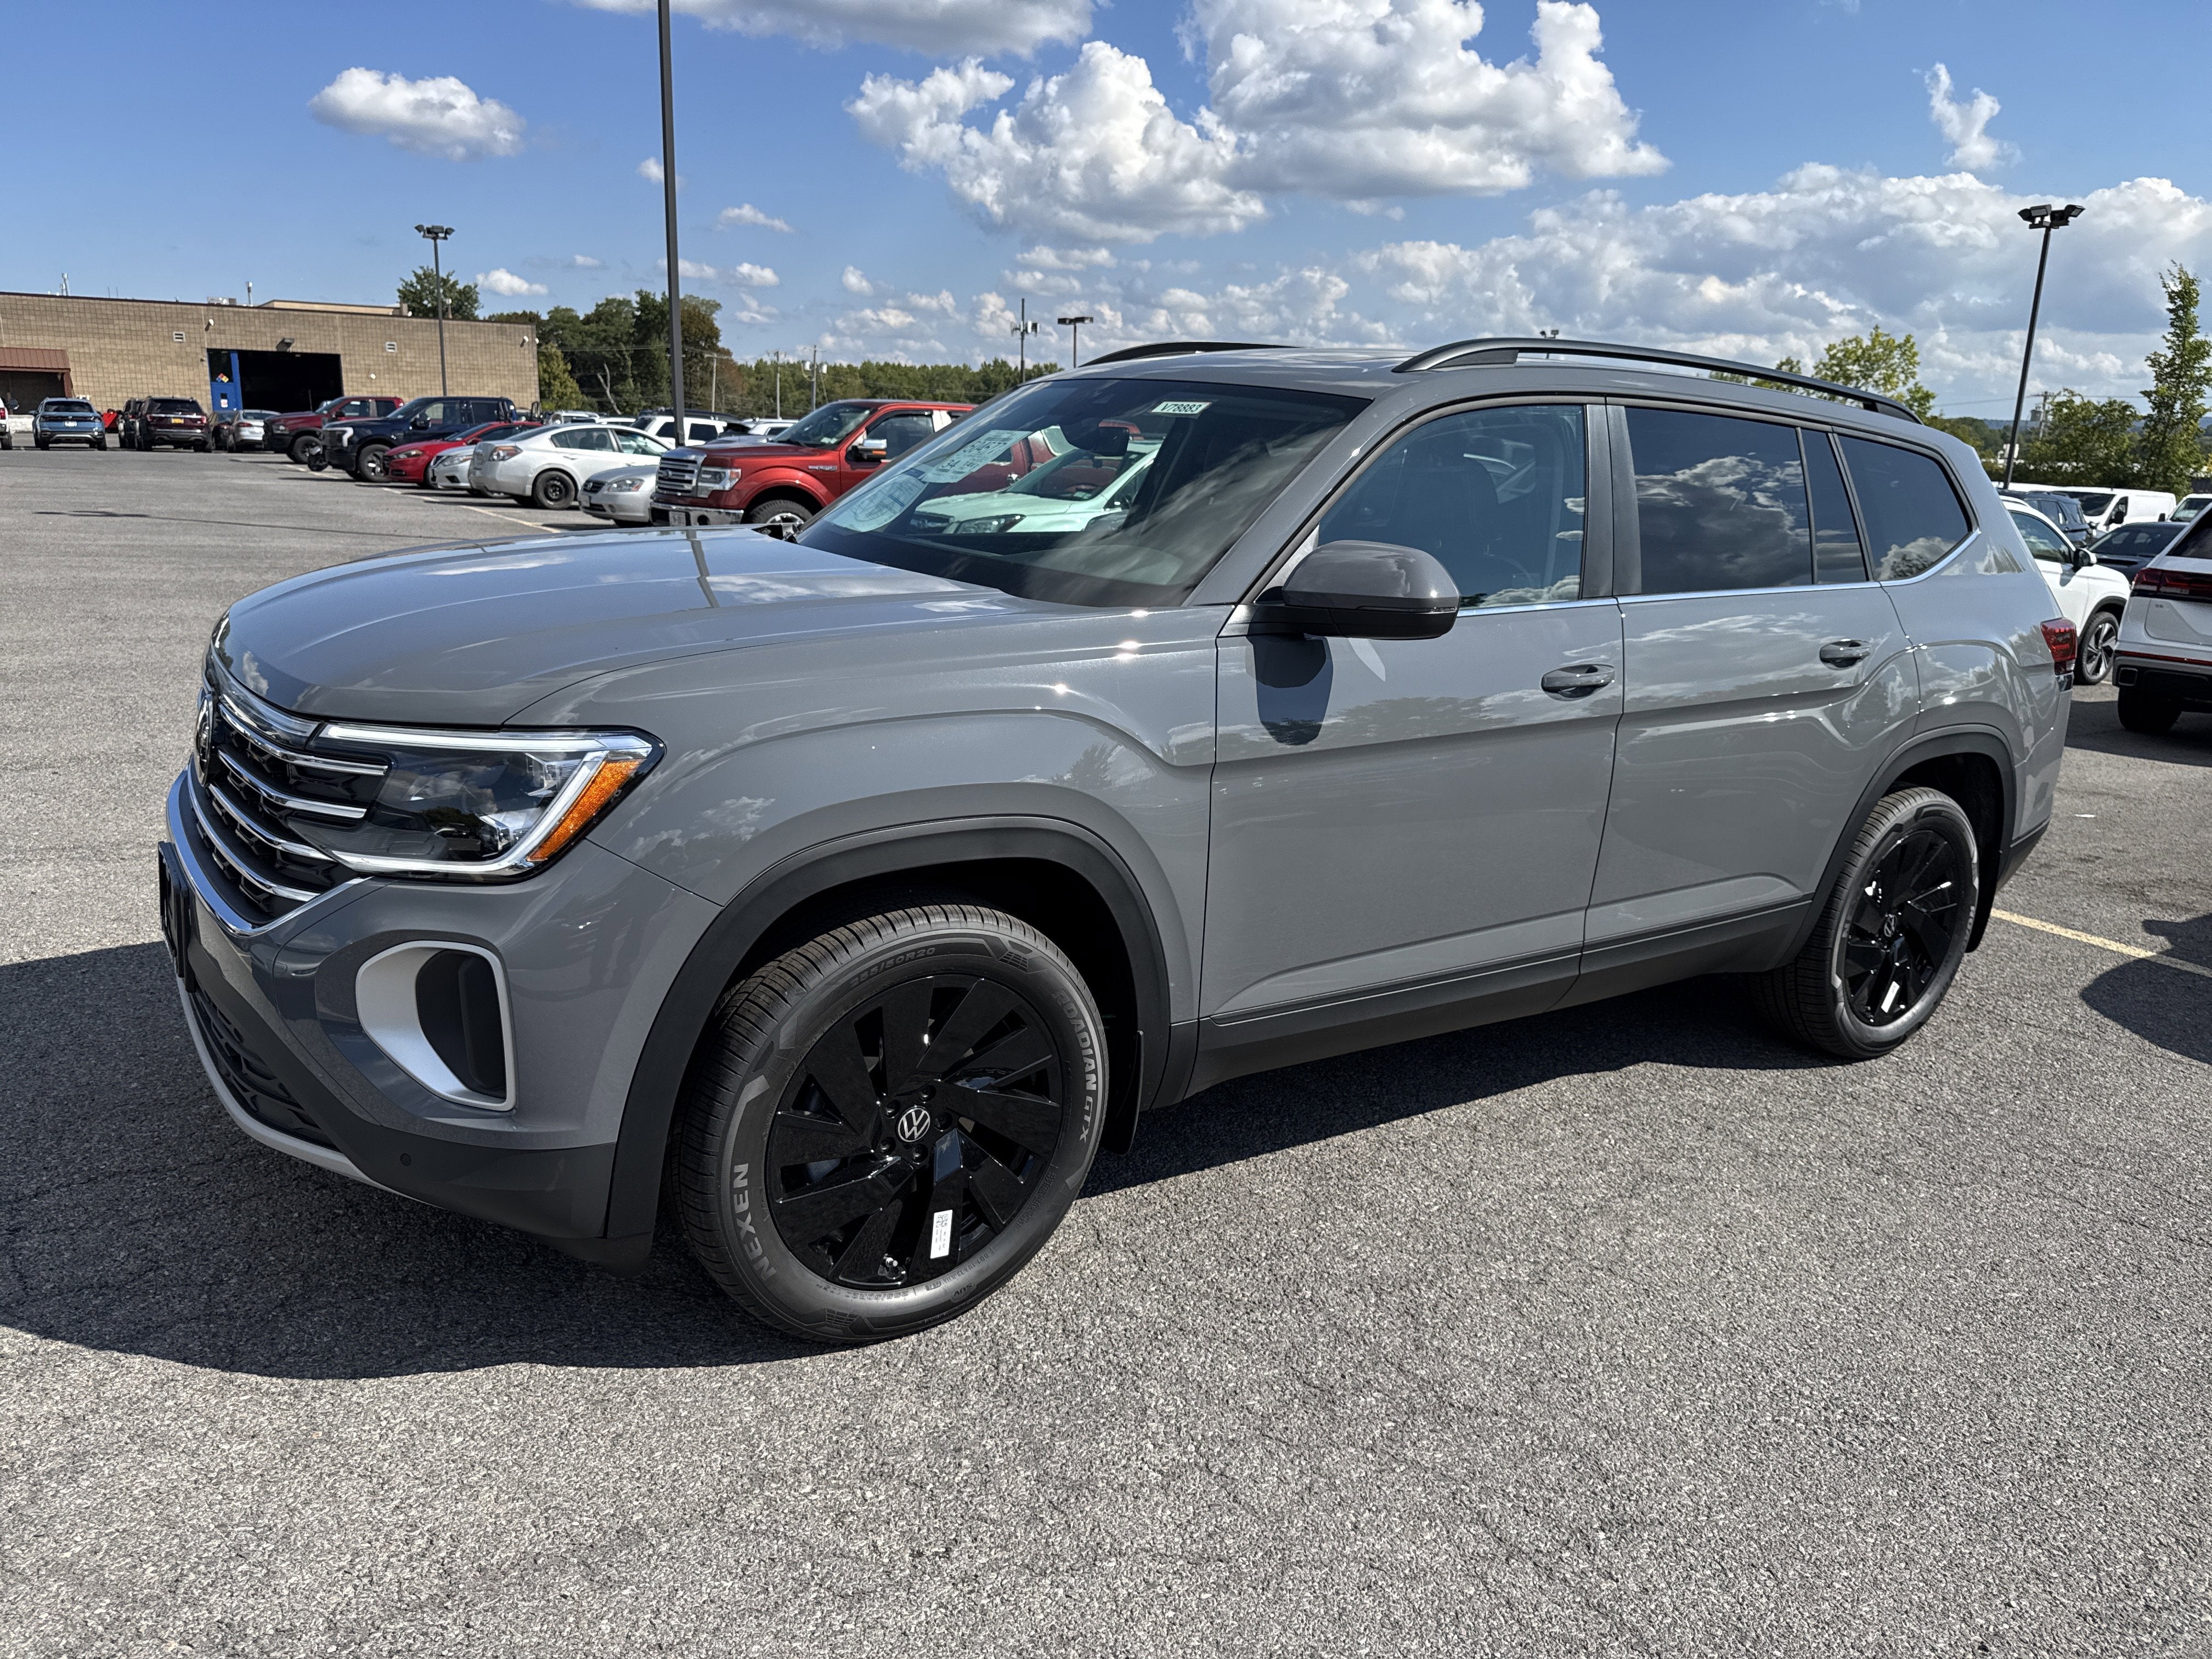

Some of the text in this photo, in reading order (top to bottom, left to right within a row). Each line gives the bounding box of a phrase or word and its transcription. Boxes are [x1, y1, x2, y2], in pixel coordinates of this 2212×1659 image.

[1160, 403, 1202, 413] V78883
[941, 460, 961, 469] 34
[851, 947, 936, 987] 255/50R20
[1052, 989, 1097, 1143] ROADIAN GTX
[733, 1163, 777, 1281] NEXEN
[953, 1283, 973, 1296] SUV
